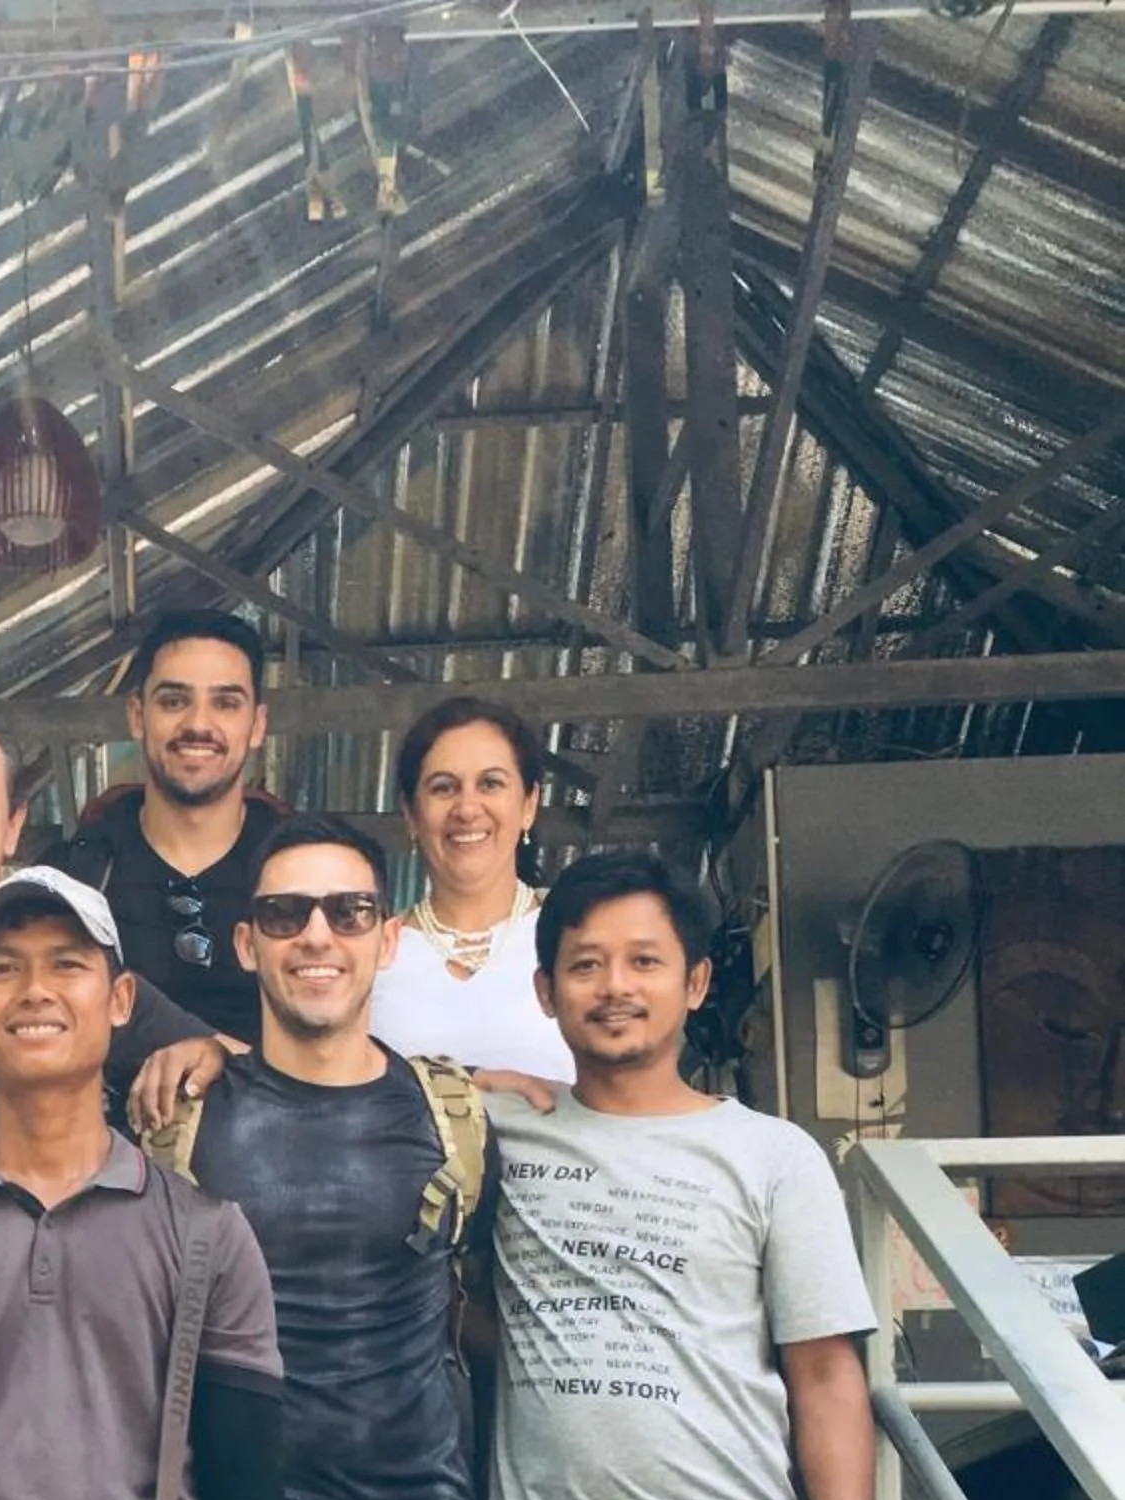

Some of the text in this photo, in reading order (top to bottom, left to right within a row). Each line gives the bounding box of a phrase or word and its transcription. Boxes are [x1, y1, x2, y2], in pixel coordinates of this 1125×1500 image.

[507, 1163, 599, 1182] NEW DAY
[635, 1212, 661, 1224] NEW
[561, 1239, 610, 1258] NEW
[615, 1244, 689, 1274] PLACE
[554, 1379, 602, 1395] NEW
[607, 1380, 683, 1404] STORY
